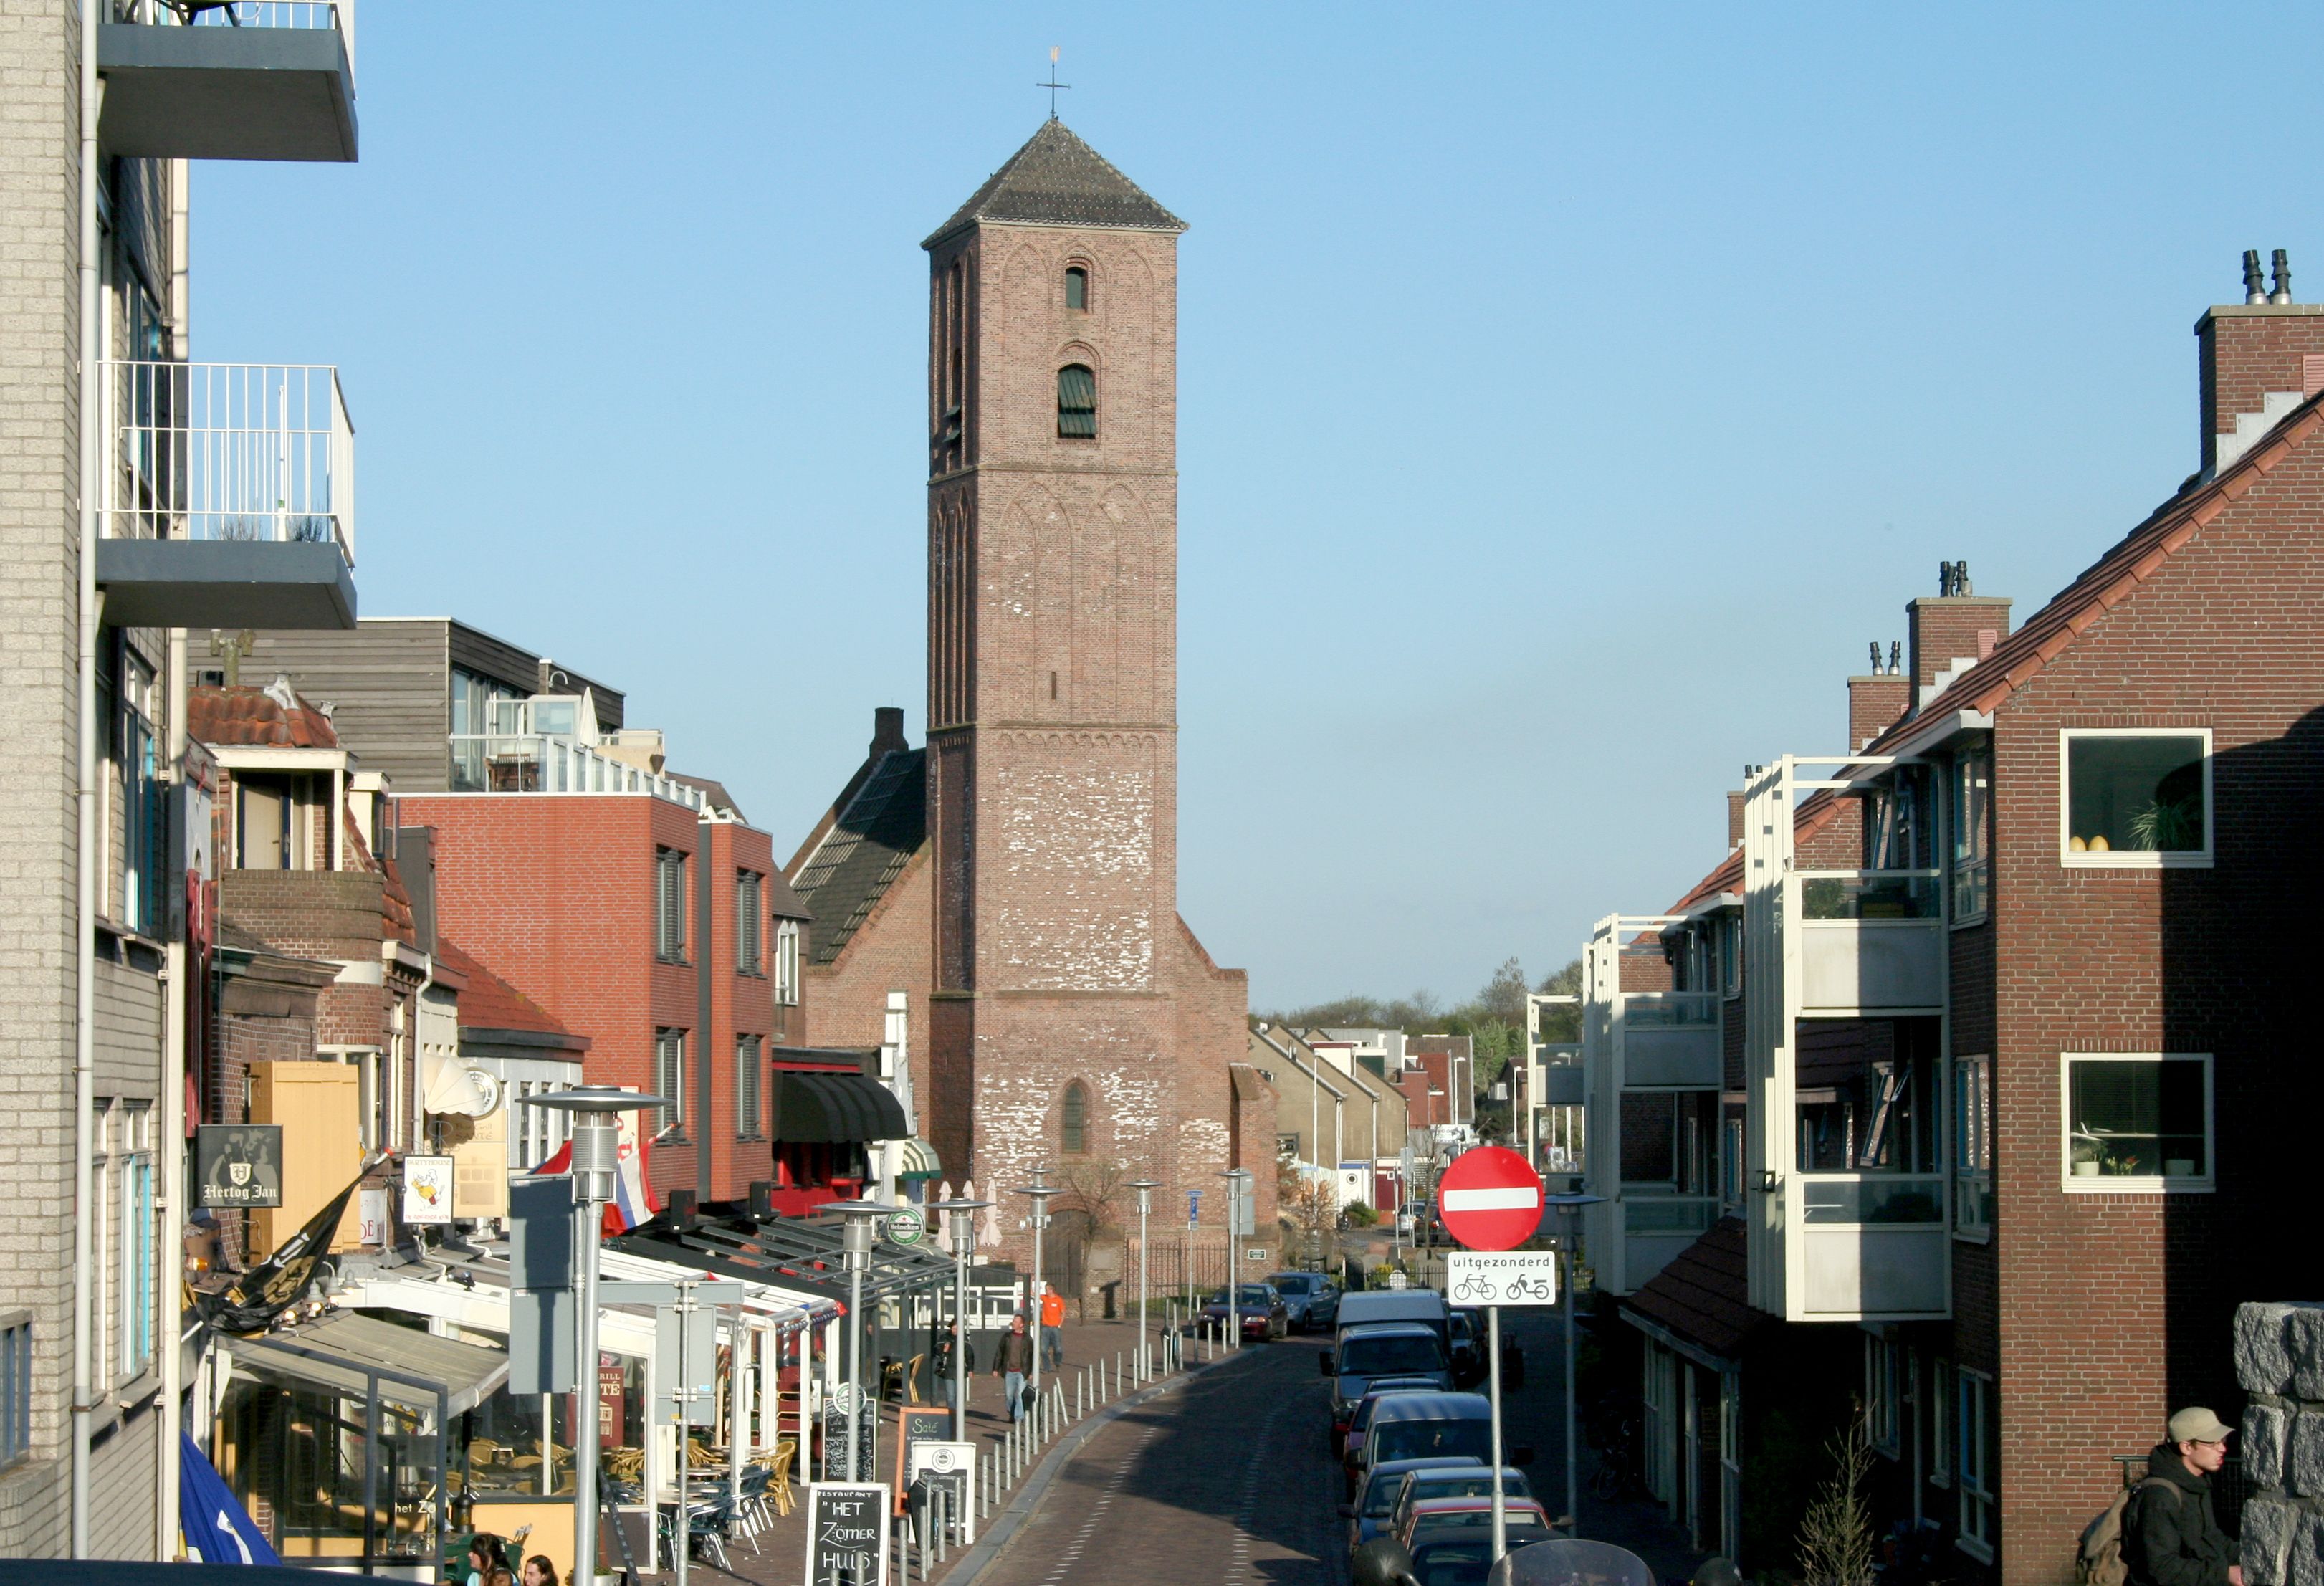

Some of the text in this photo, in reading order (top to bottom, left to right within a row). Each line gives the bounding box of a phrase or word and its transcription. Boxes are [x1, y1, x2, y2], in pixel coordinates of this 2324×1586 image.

[203, 1185, 277, 1203] Hertog Jan
[1453, 1256, 1549, 1270] uitgezonderd
